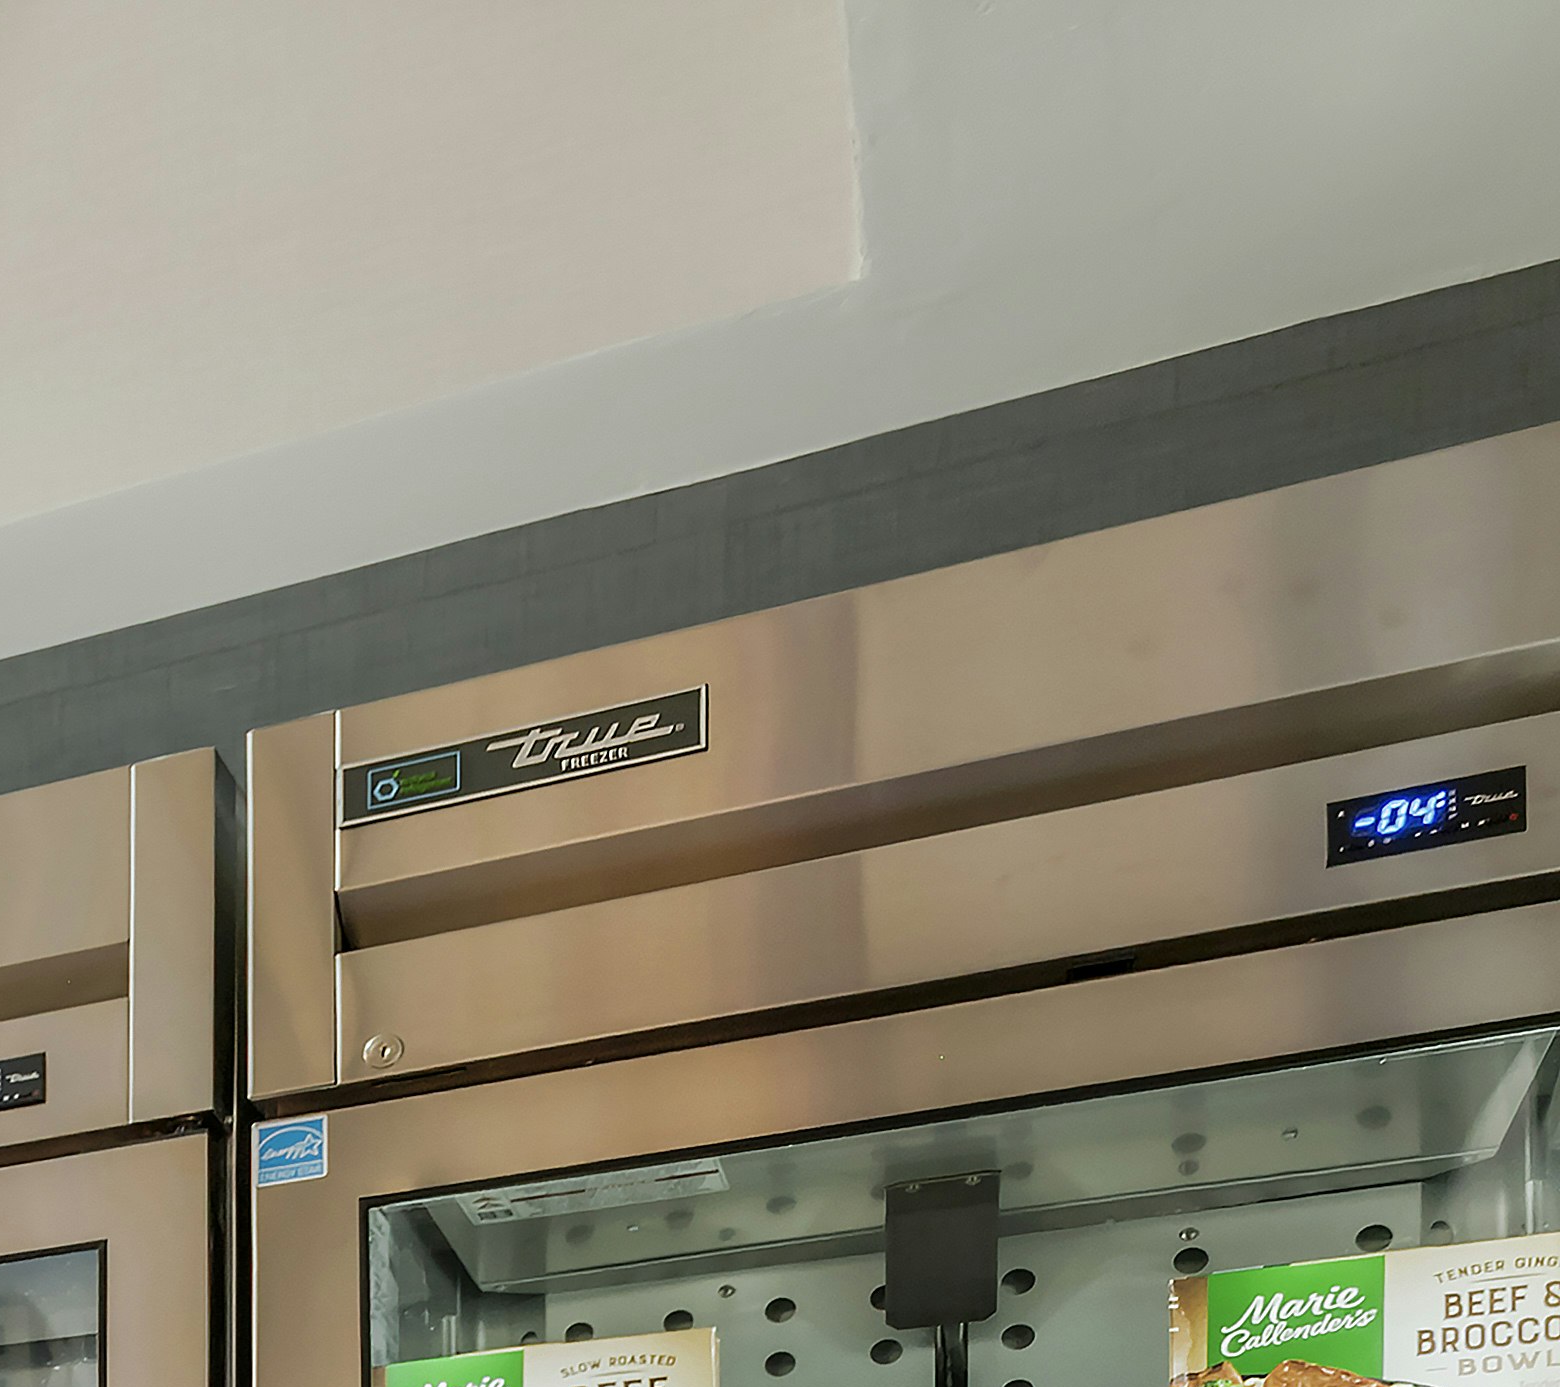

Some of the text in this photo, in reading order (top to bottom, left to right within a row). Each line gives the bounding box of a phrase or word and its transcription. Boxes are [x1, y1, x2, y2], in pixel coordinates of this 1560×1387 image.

[560, 746, 628, 772] FREEZER
[1434, 1258, 1506, 1285] TENDER
[1221, 1284, 1366, 1333] Marie
[1444, 1283, 1529, 1322] BEEF
[1220, 1307, 1378, 1359] Callender's
[560, 1354, 677, 1379] SLOW ROASTED
[1458, 1350, 1560, 1377] BOWL
